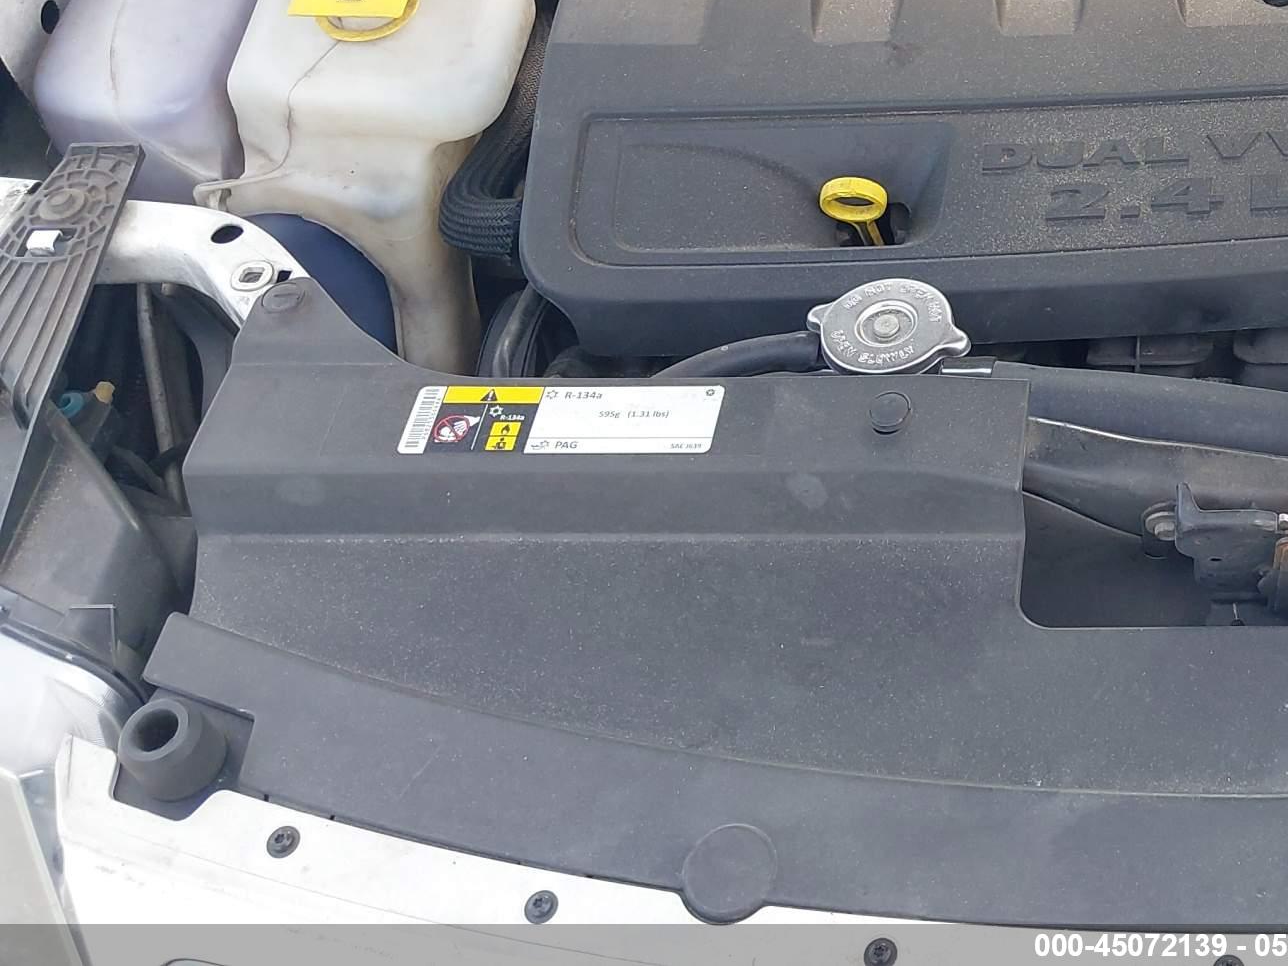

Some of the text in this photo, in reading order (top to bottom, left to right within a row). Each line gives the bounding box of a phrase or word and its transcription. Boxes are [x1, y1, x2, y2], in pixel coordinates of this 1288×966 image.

[982, 138, 1190, 175] DUAL
[564, 391, 603, 400] R-134a
[598, 410, 670, 419] 595g (1.31 lbs)
[554, 440, 579, 449] PAG
